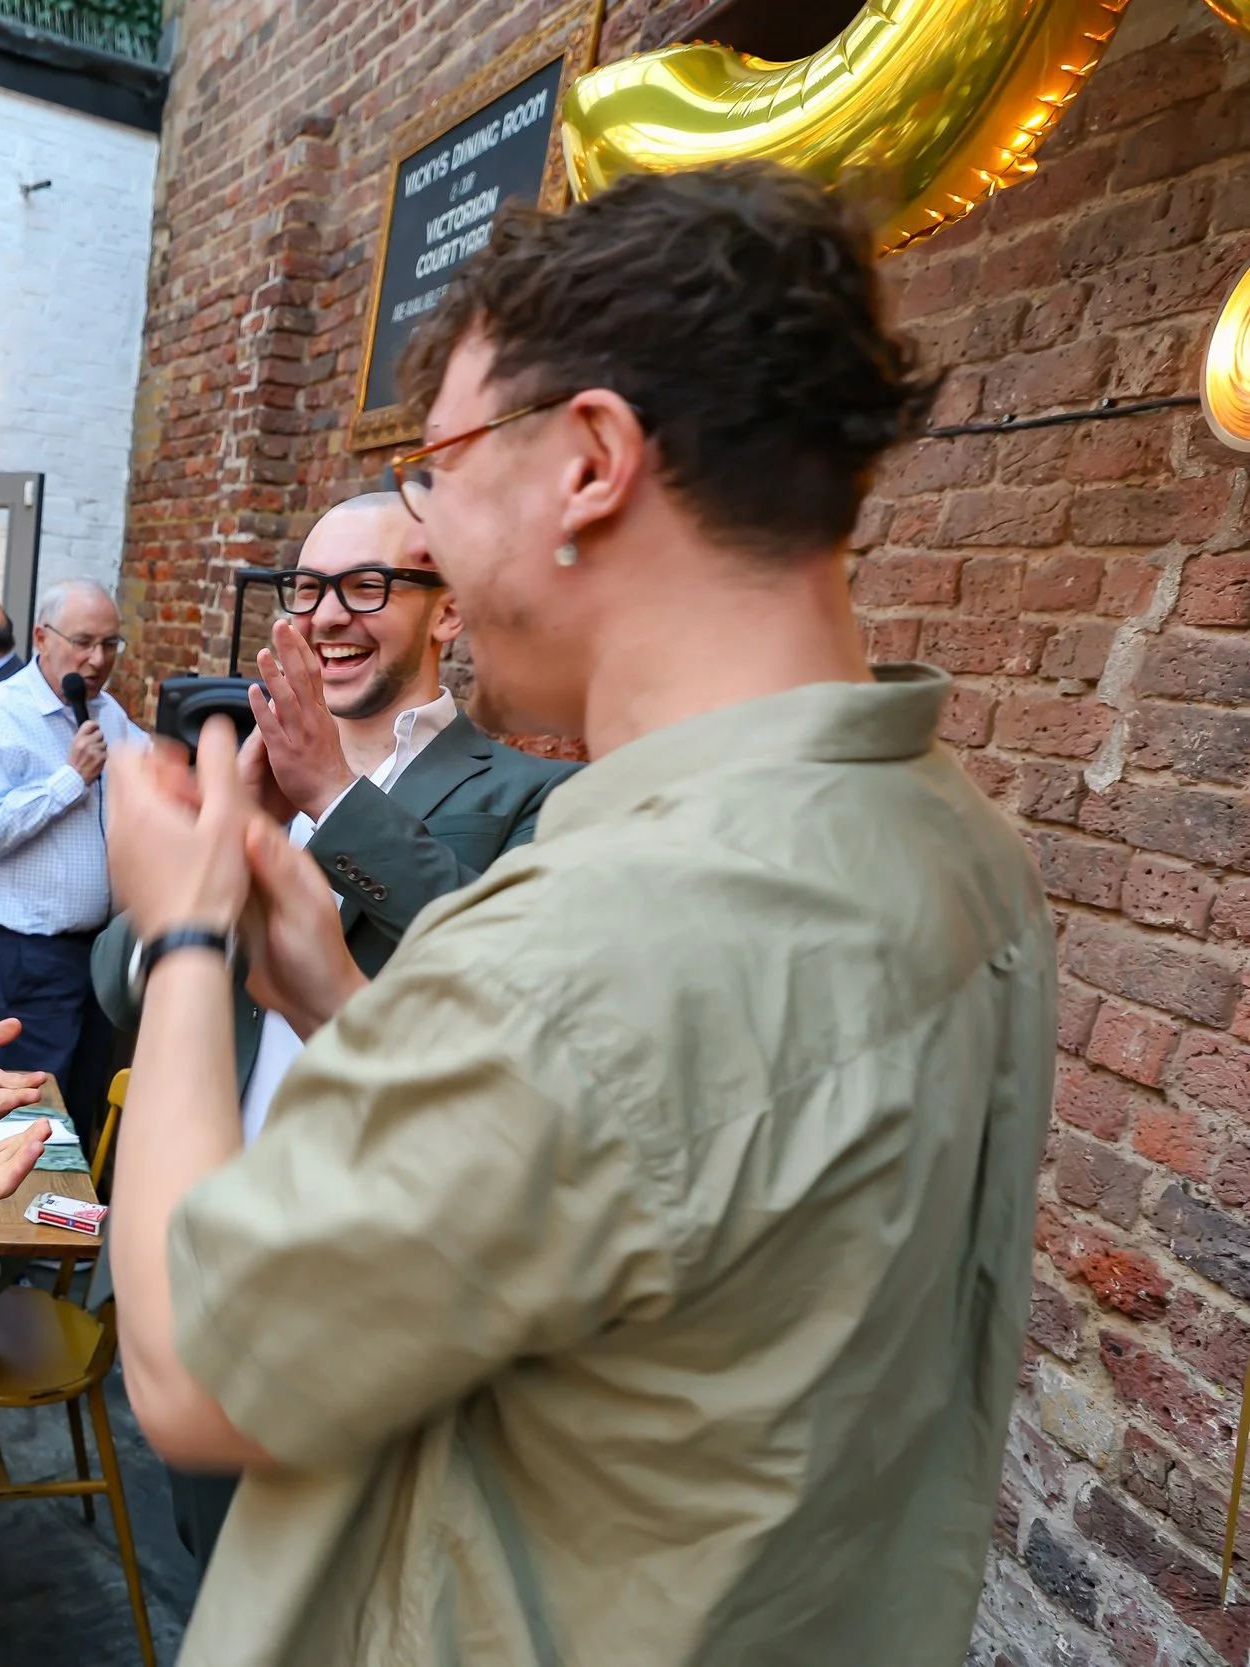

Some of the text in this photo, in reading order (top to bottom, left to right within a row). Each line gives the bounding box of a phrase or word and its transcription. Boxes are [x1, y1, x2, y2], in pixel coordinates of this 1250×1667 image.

[451, 119, 500, 171] DINING
[501, 88, 548, 140] ROOM
[426, 185, 500, 245] VICTORIAN
